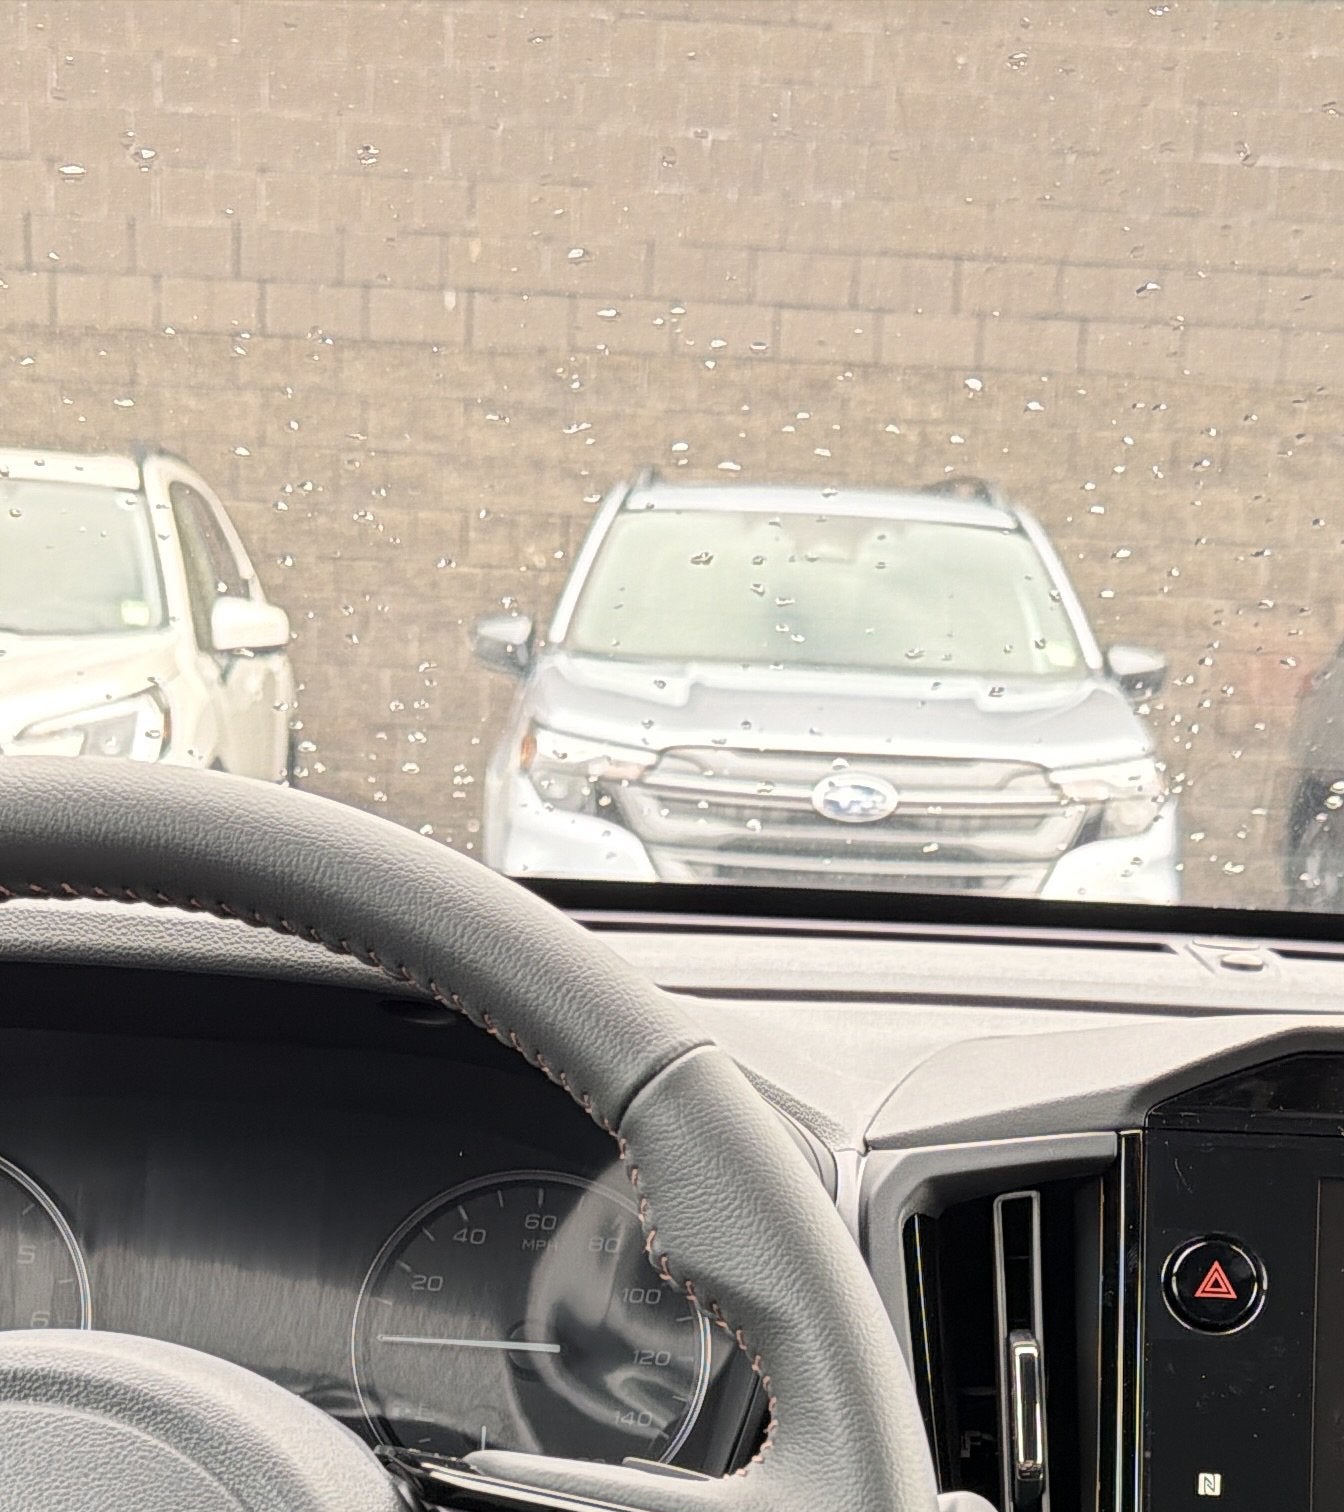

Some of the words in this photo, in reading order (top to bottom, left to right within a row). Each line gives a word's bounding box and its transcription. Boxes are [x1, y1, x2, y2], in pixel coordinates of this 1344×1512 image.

[524, 1214, 557, 1231] 60
[452, 1228, 487, 1246] 40
[521, 1238, 558, 1251] MPH
[588, 1236, 622, 1254] 80
[16, 1244, 36, 1265] 5
[410, 1274, 444, 1292] 20
[621, 1287, 662, 1305] 100
[30, 1310, 51, 1328] 6
[632, 1349, 672, 1367] 120
[614, 1409, 654, 1428] 140
